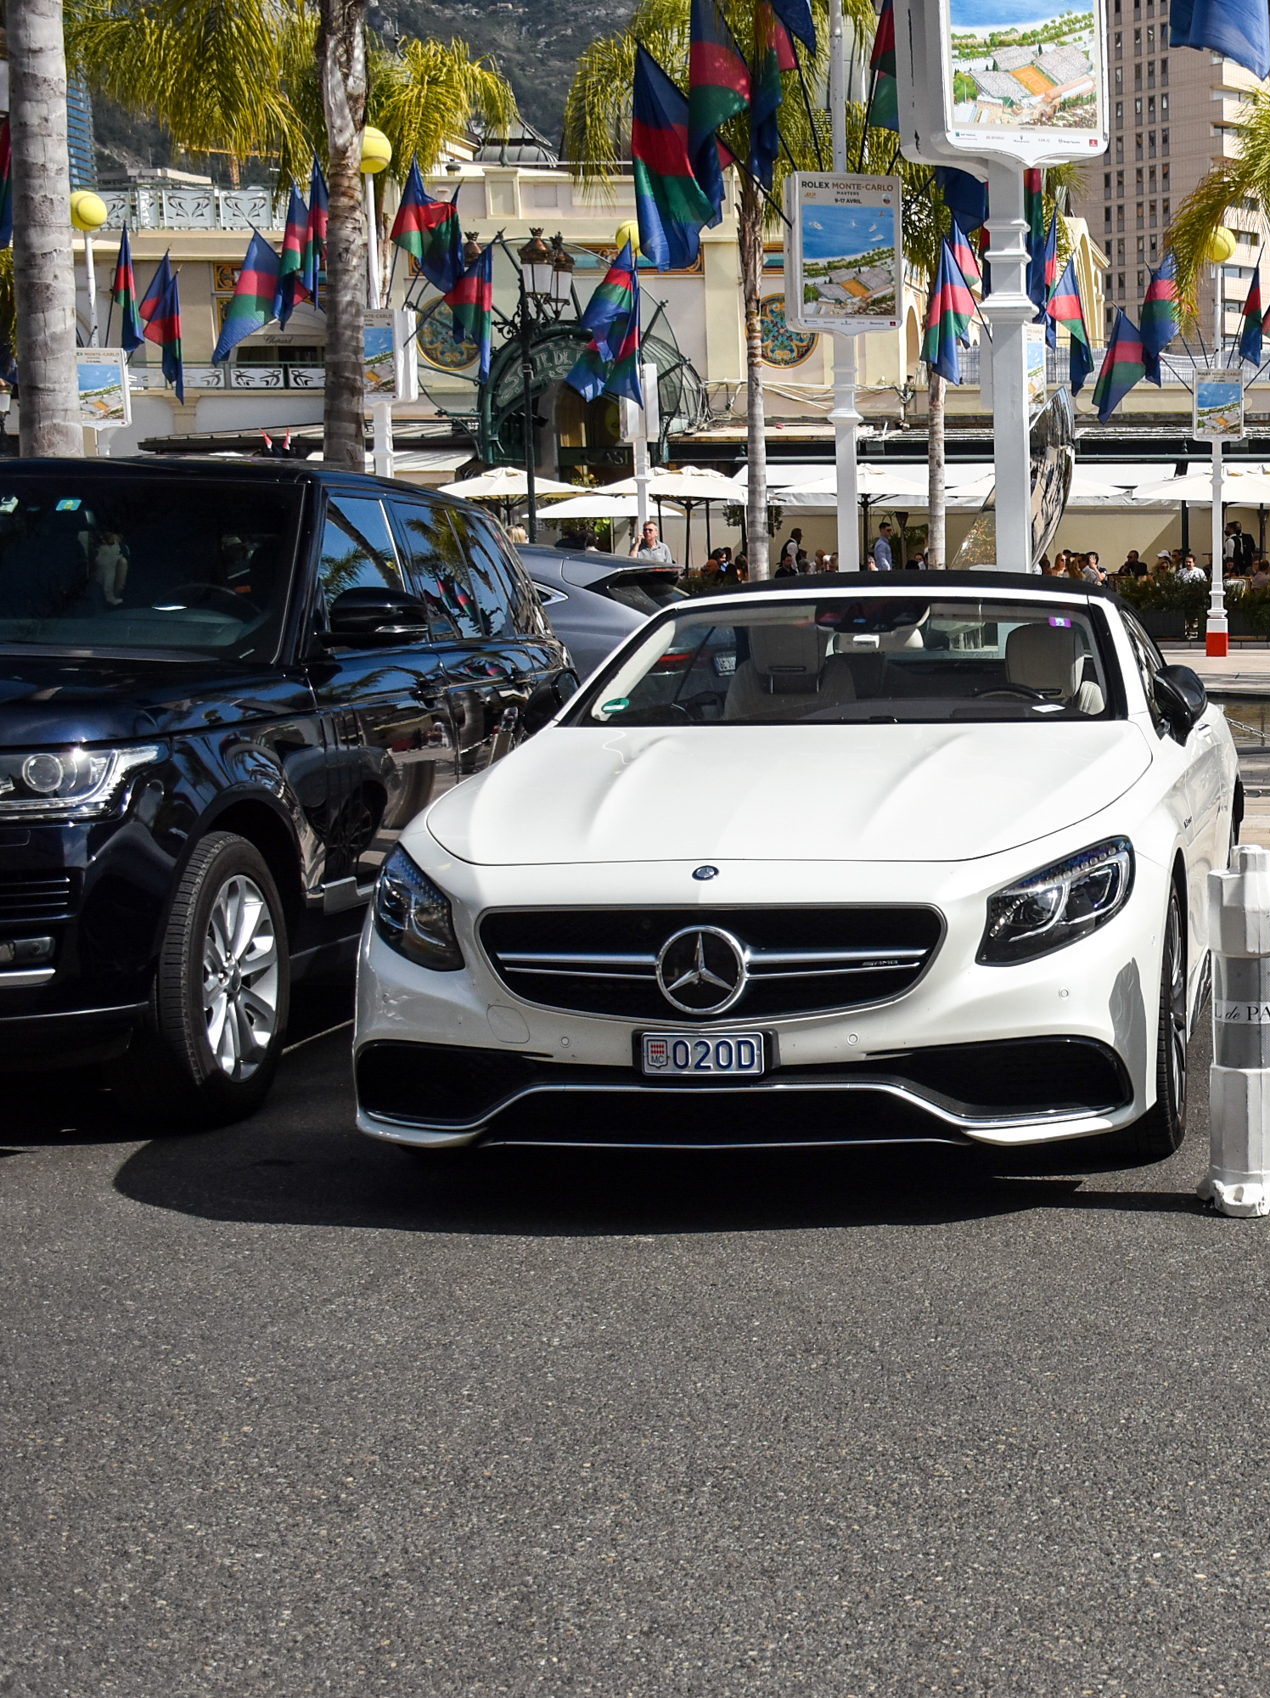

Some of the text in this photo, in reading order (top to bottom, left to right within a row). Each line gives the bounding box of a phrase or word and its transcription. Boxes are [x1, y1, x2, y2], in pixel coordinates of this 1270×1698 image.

[802, 181, 894, 192] ROLEX MONTE-CARLO
[1225, 1006, 1240, 1020] de
[650, 1055, 665, 1064] MC
[673, 1038, 757, 1070] 020D
